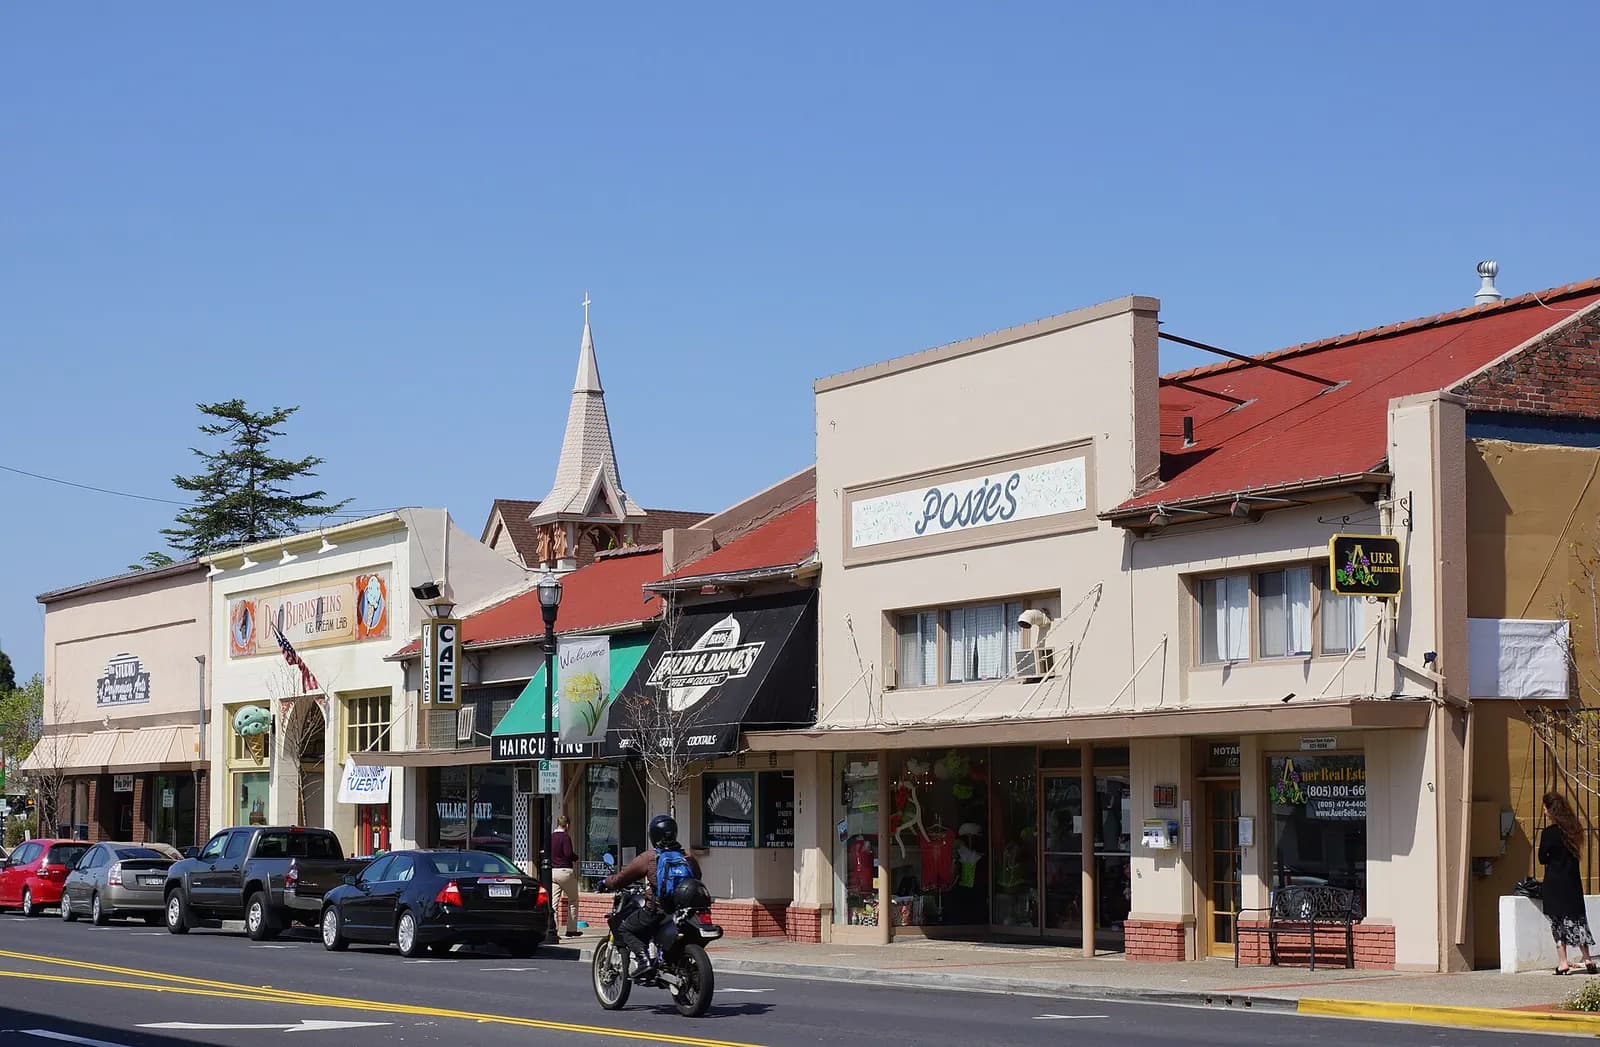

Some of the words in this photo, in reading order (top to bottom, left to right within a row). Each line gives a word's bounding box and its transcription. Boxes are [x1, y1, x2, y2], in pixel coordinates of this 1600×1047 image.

[336, 616, 348, 631] LAB
[439, 625, 454, 702] CAFE
[560, 647, 606, 669] Welcome
[651, 655, 698, 682] RALPH
[694, 653, 706, 673] &
[703, 646, 759, 674] DUANE'S
[115, 662, 136, 678] STUDIO
[500, 737, 583, 756] HAIRCUTING
[687, 735, 717, 746] COCKTAILS
[541, 761, 548, 770] 2
[1321, 767, 1344, 781] Real
[1307, 785, 1331, 798] (805)
[1333, 785, 1367, 797] 801-66
[435, 802, 467, 819] VILLAGE
[474, 802, 492, 819] CAFE
